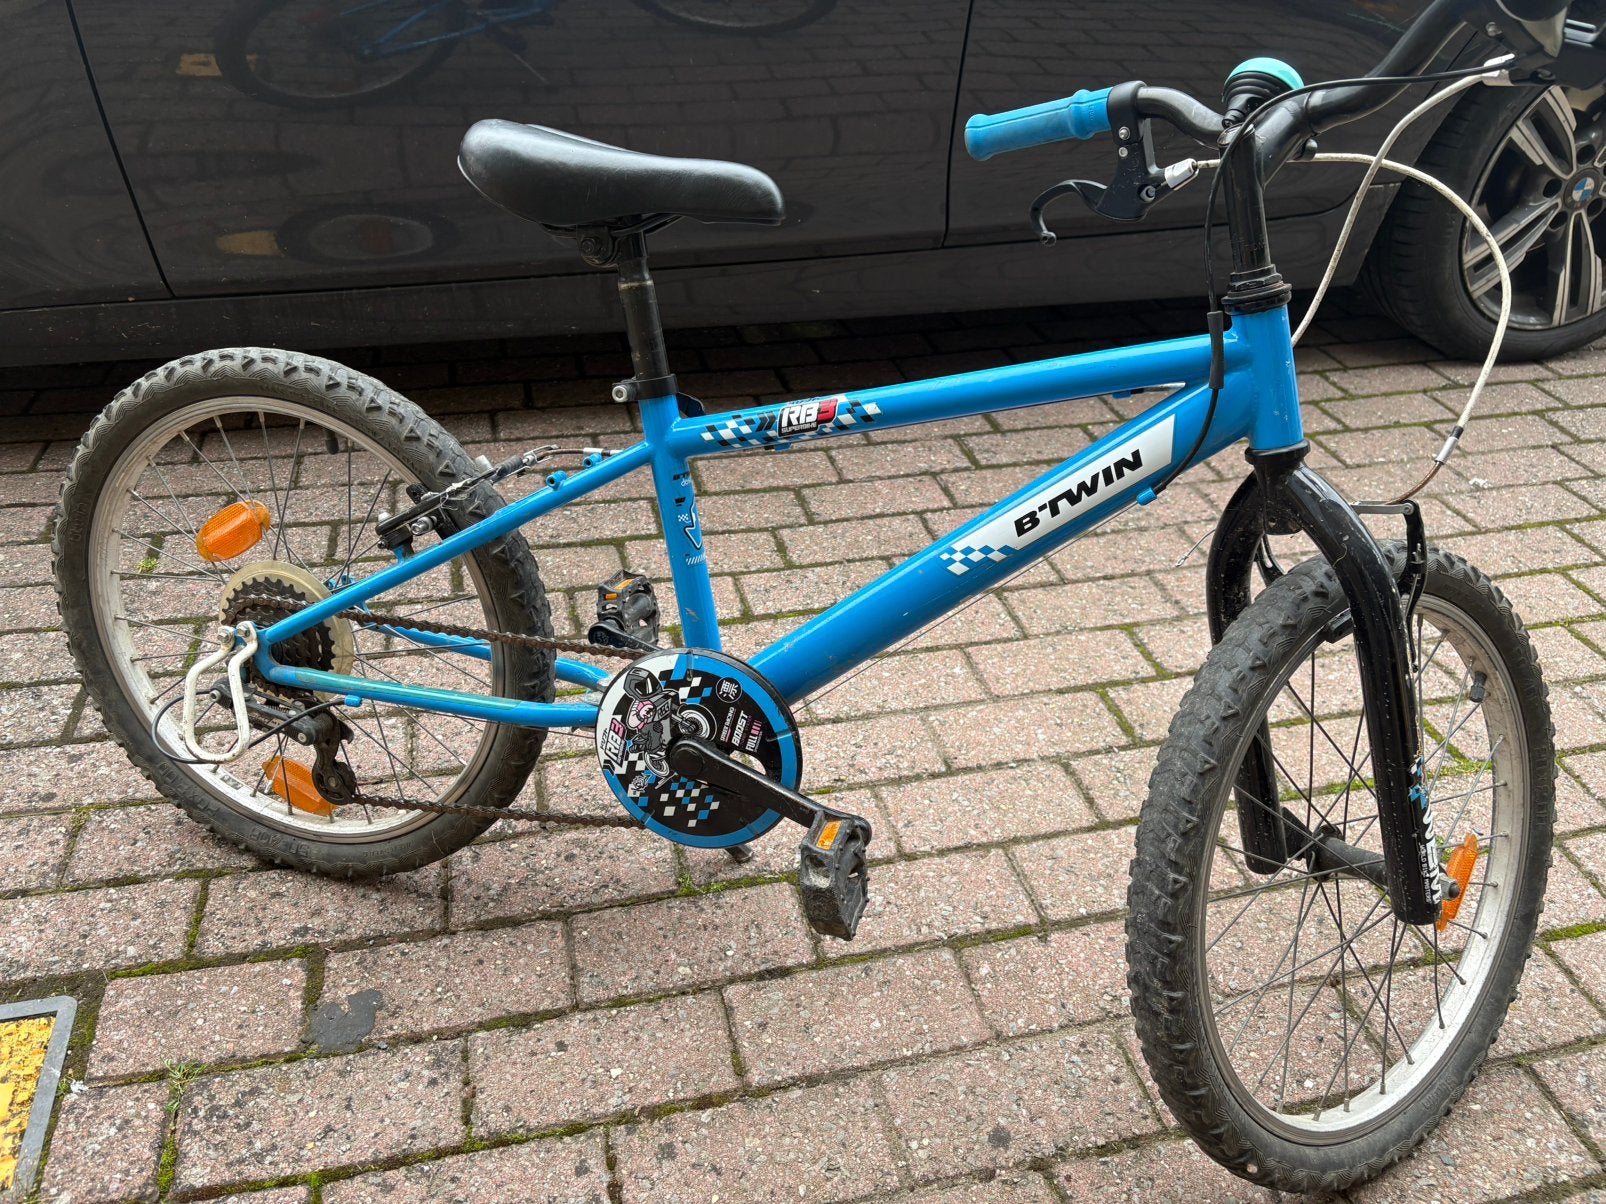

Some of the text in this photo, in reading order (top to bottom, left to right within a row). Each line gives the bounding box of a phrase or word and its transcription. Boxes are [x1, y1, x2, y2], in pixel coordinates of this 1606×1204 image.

[782, 399, 837, 428] RB3
[605, 719, 625, 760] RB3
[731, 711, 748, 747] BOOST
